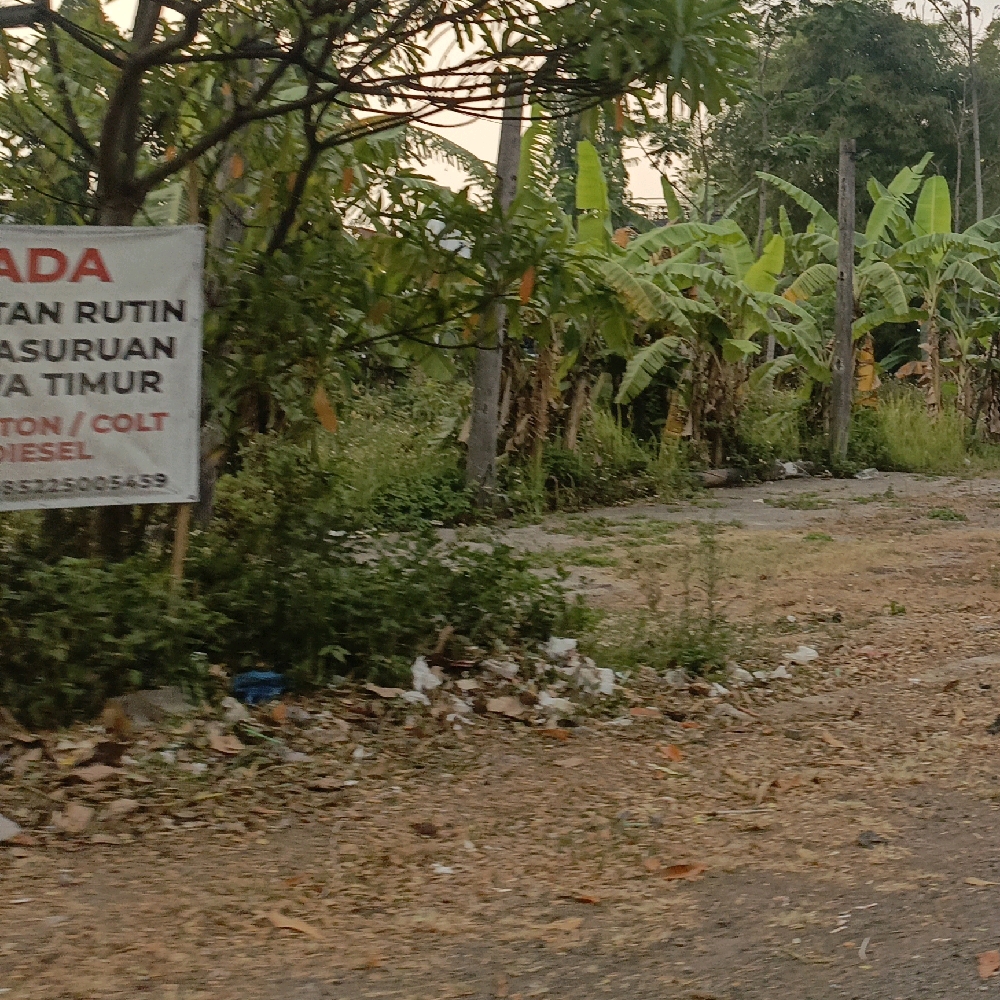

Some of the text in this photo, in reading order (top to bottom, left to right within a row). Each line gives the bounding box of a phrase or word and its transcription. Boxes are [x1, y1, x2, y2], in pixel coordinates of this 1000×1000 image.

[76, 300, 186, 323] RUTIN
[41, 370, 164, 396] TIMUR
[92, 412, 170, 433] COLT
